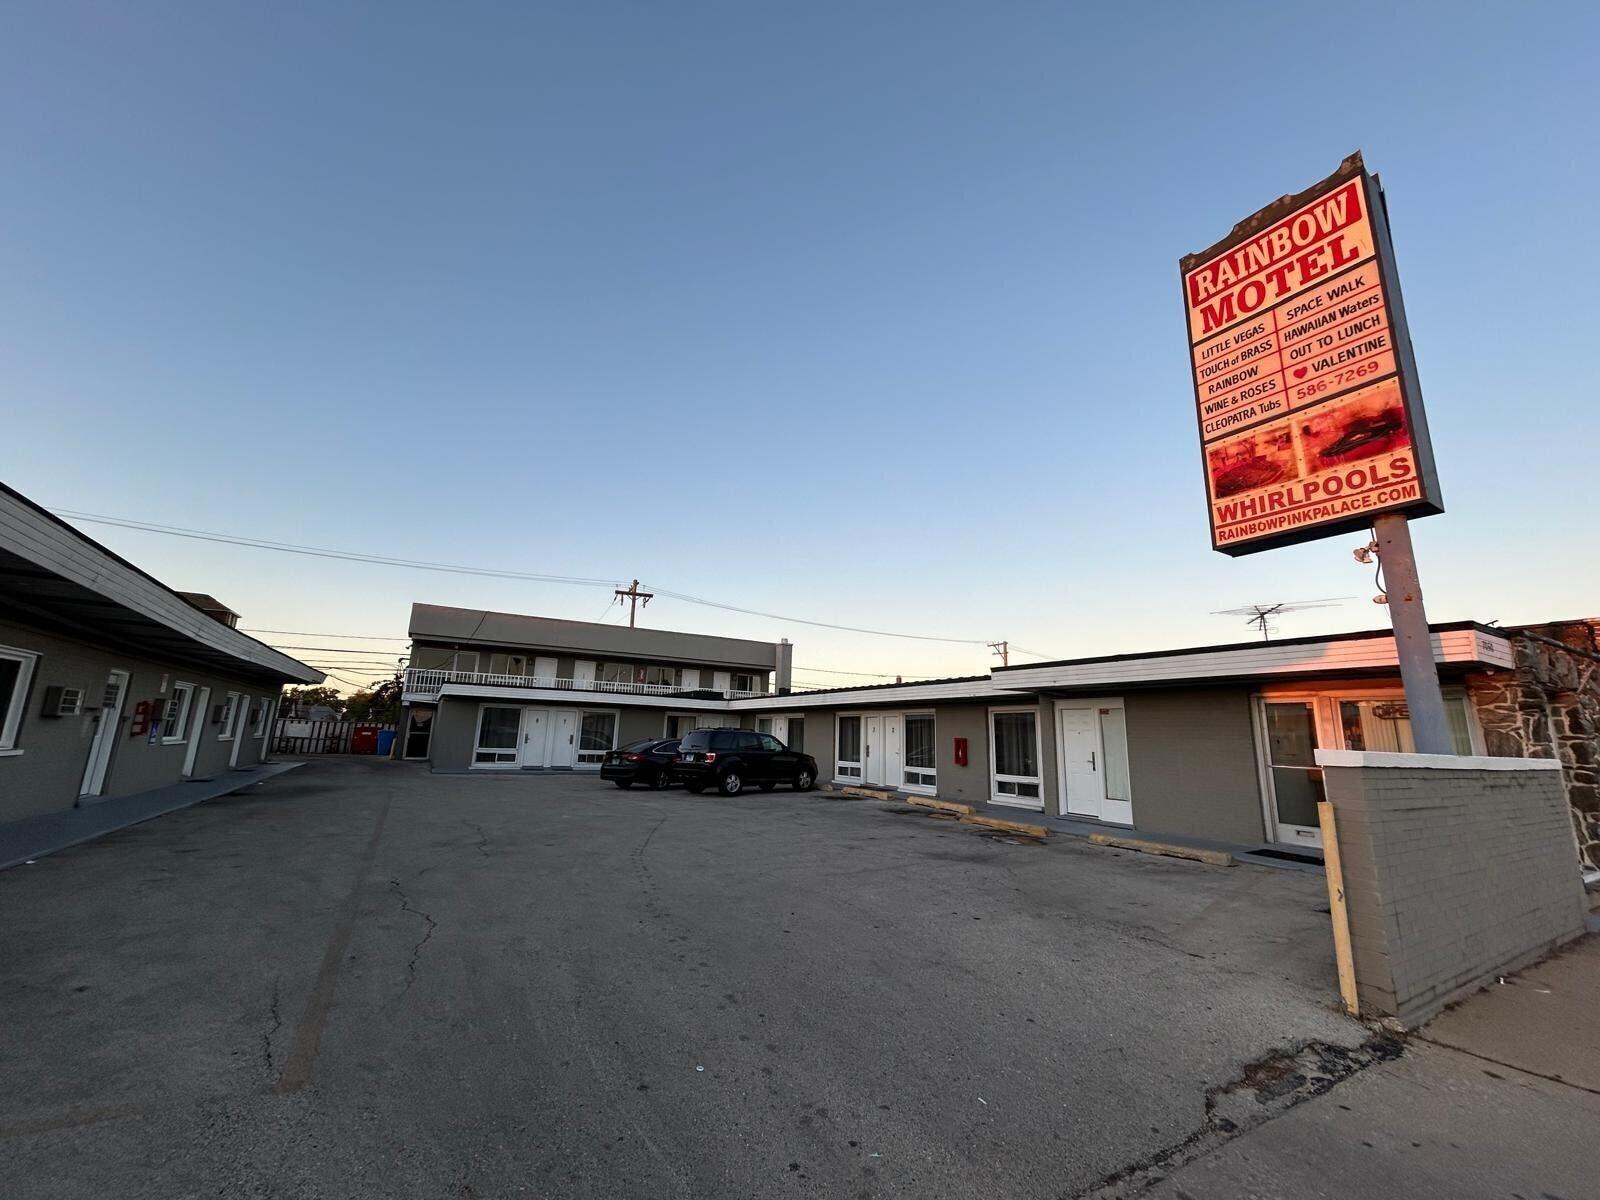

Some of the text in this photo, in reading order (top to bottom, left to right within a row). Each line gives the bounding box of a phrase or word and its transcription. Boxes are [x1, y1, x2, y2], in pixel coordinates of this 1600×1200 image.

[1195, 192, 1348, 301] RAINBOW
[1200, 234, 1360, 335] MOTEL
[1286, 276, 1366, 321] SPACE WALK
[1284, 294, 1380, 342] HAWAIIAN Waters
[1290, 314, 1381, 360] OUT TO LUNCH
[1200, 340, 1273, 379] TOUCH of BRASS
[1202, 323, 1265, 360] LITTLE VEGAS
[1311, 336, 1387, 373] VALENTINE
[1204, 379, 1276, 415] WINE & ROSES
[1208, 365, 1259, 394] RAINBOW
[1296, 361, 1380, 400] 586-7269
[1205, 399, 1281, 434] CLEOPATRA Tubs
[1216, 456, 1411, 523] WHIRLPOOLS
[1218, 484, 1417, 542] RAINBOWPINKPALACE.COM
